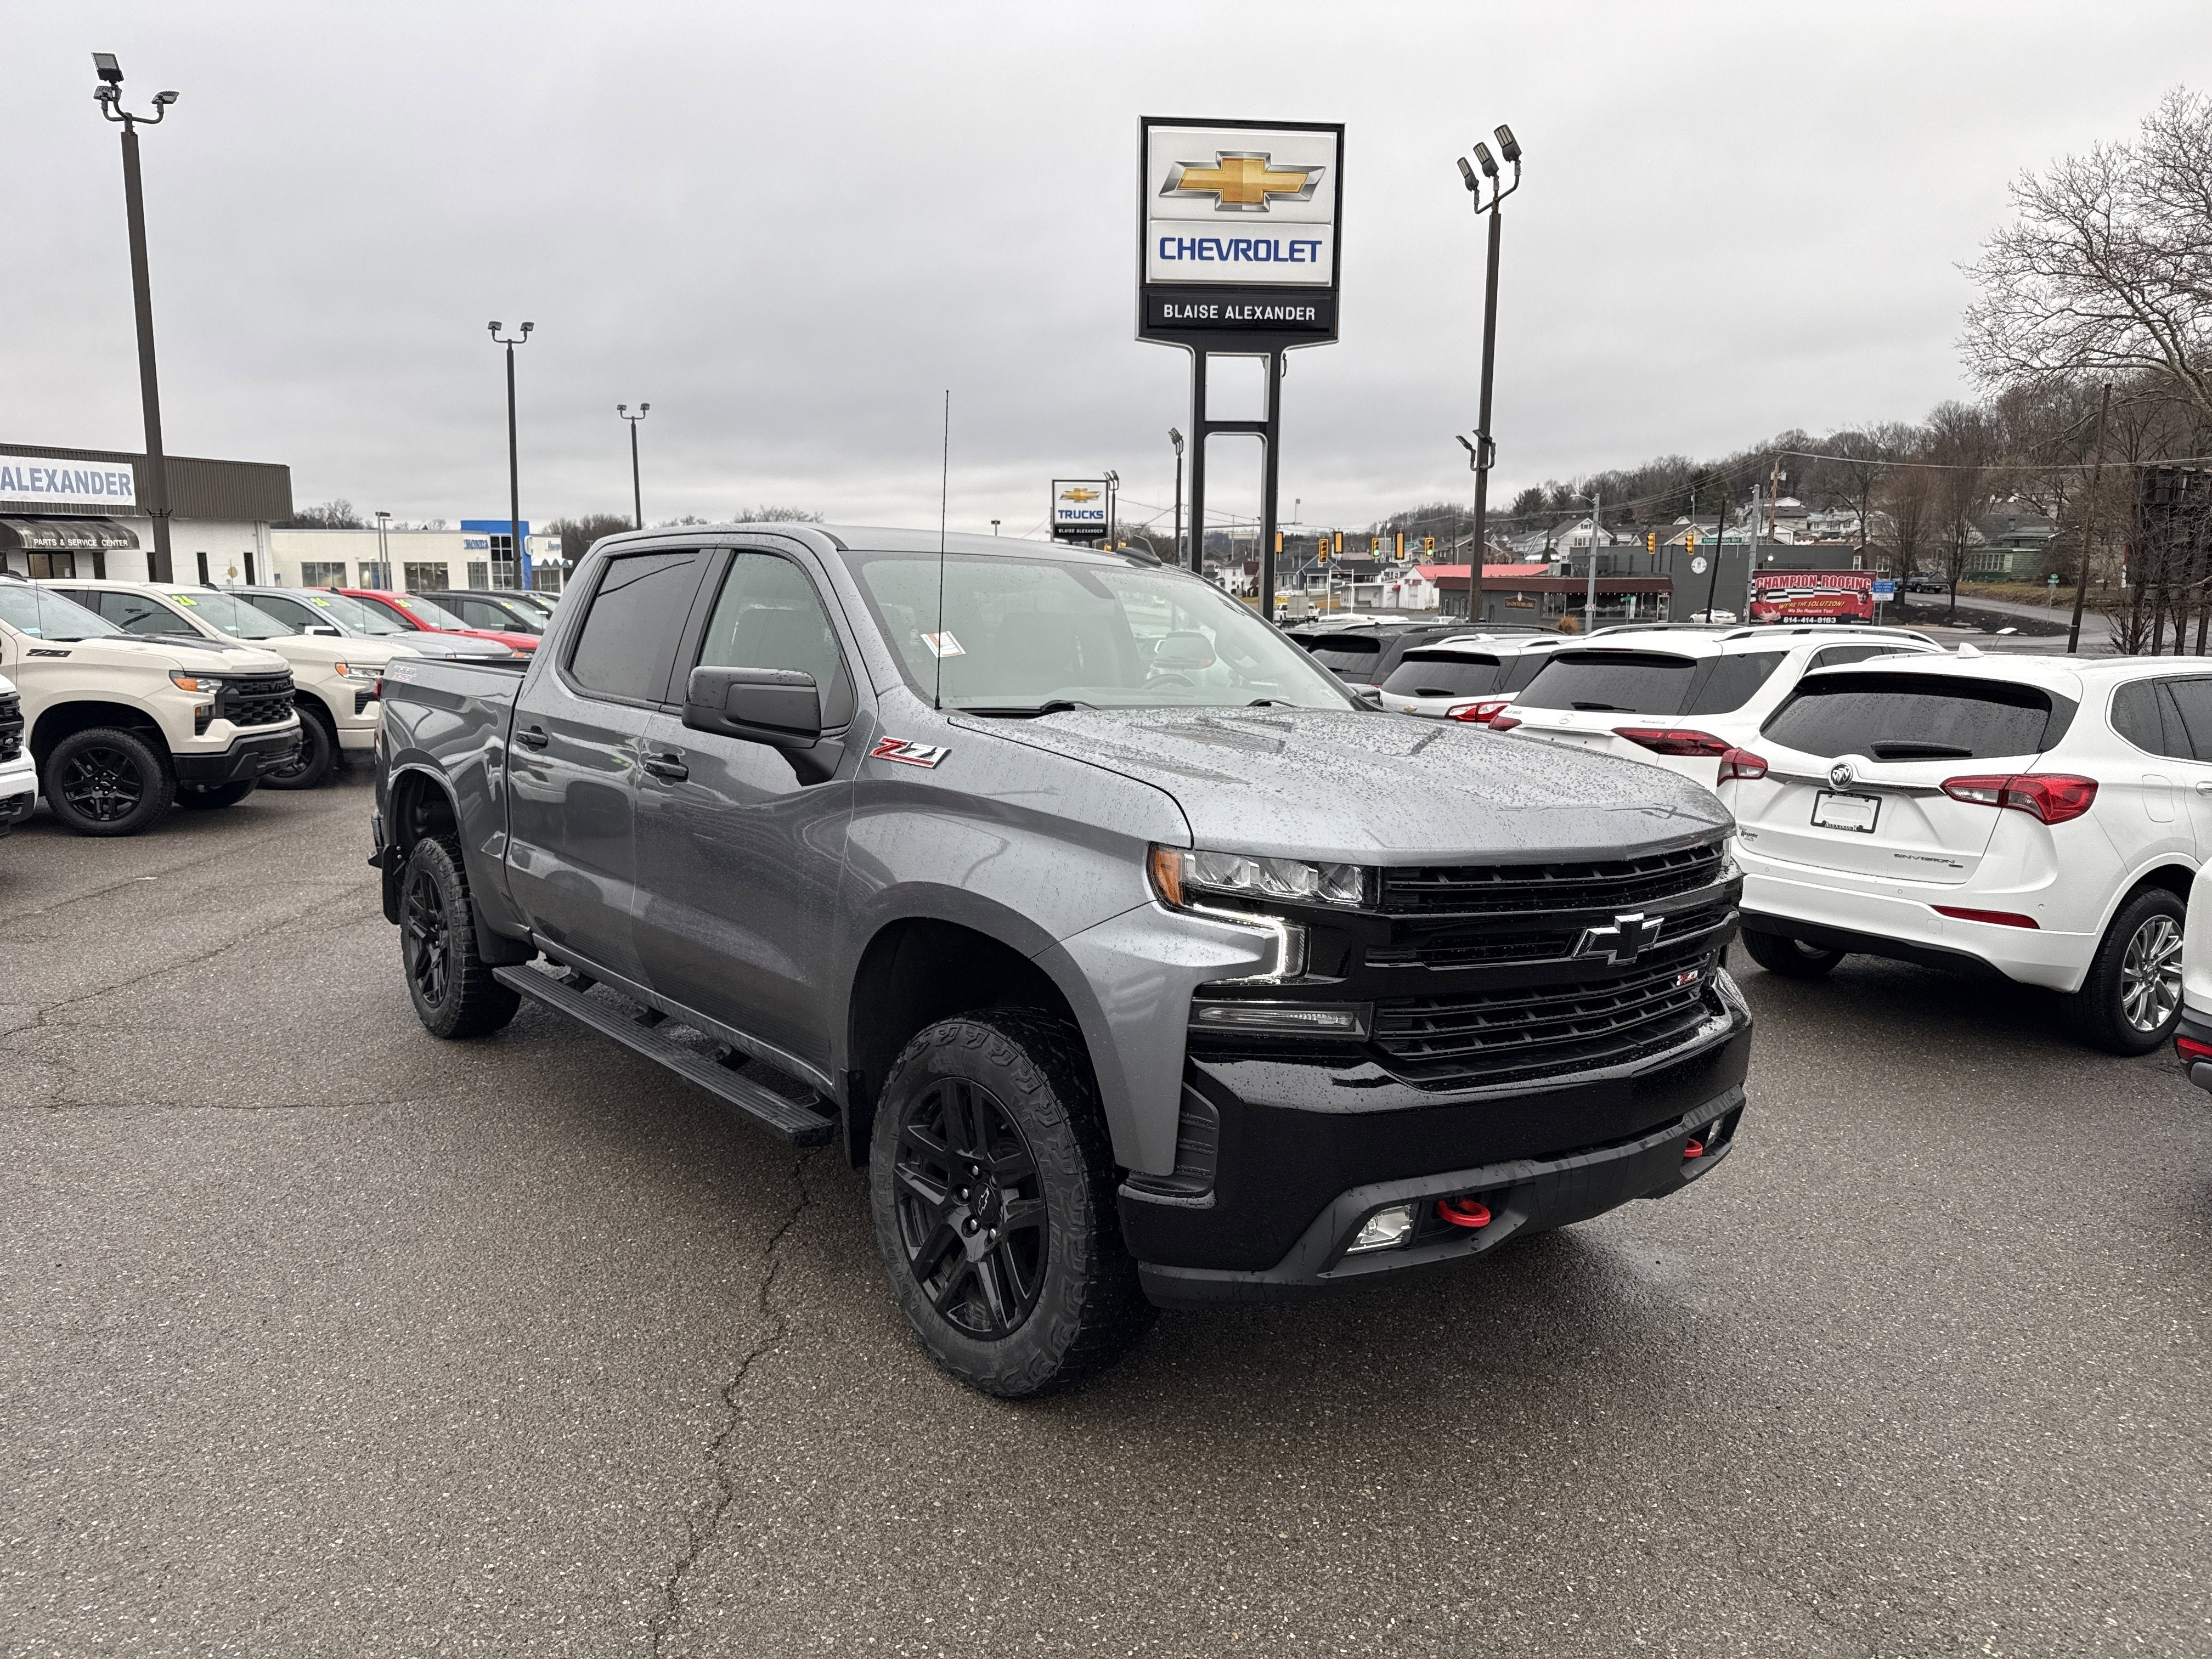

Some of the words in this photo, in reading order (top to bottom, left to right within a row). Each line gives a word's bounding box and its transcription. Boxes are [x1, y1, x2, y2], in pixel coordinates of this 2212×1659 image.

[1159, 237, 1322, 262] CHEVROLET
[1164, 304, 1218, 319] BLAISE
[1224, 306, 1315, 320] ALEXANDER
[1, 466, 132, 496] ALEXANDER
[1058, 510, 1103, 519] TRUCKS
[33, 538, 57, 546] PARTS
[67, 539, 98, 547] SERVICE
[1755, 575, 1818, 590] CHAMPION
[1821, 575, 1872, 591] ROOFING
[869, 736, 952, 769] Z71
[1825, 822, 1858, 831] ALEXANDER
[1894, 853, 1955, 864] ENVISION
